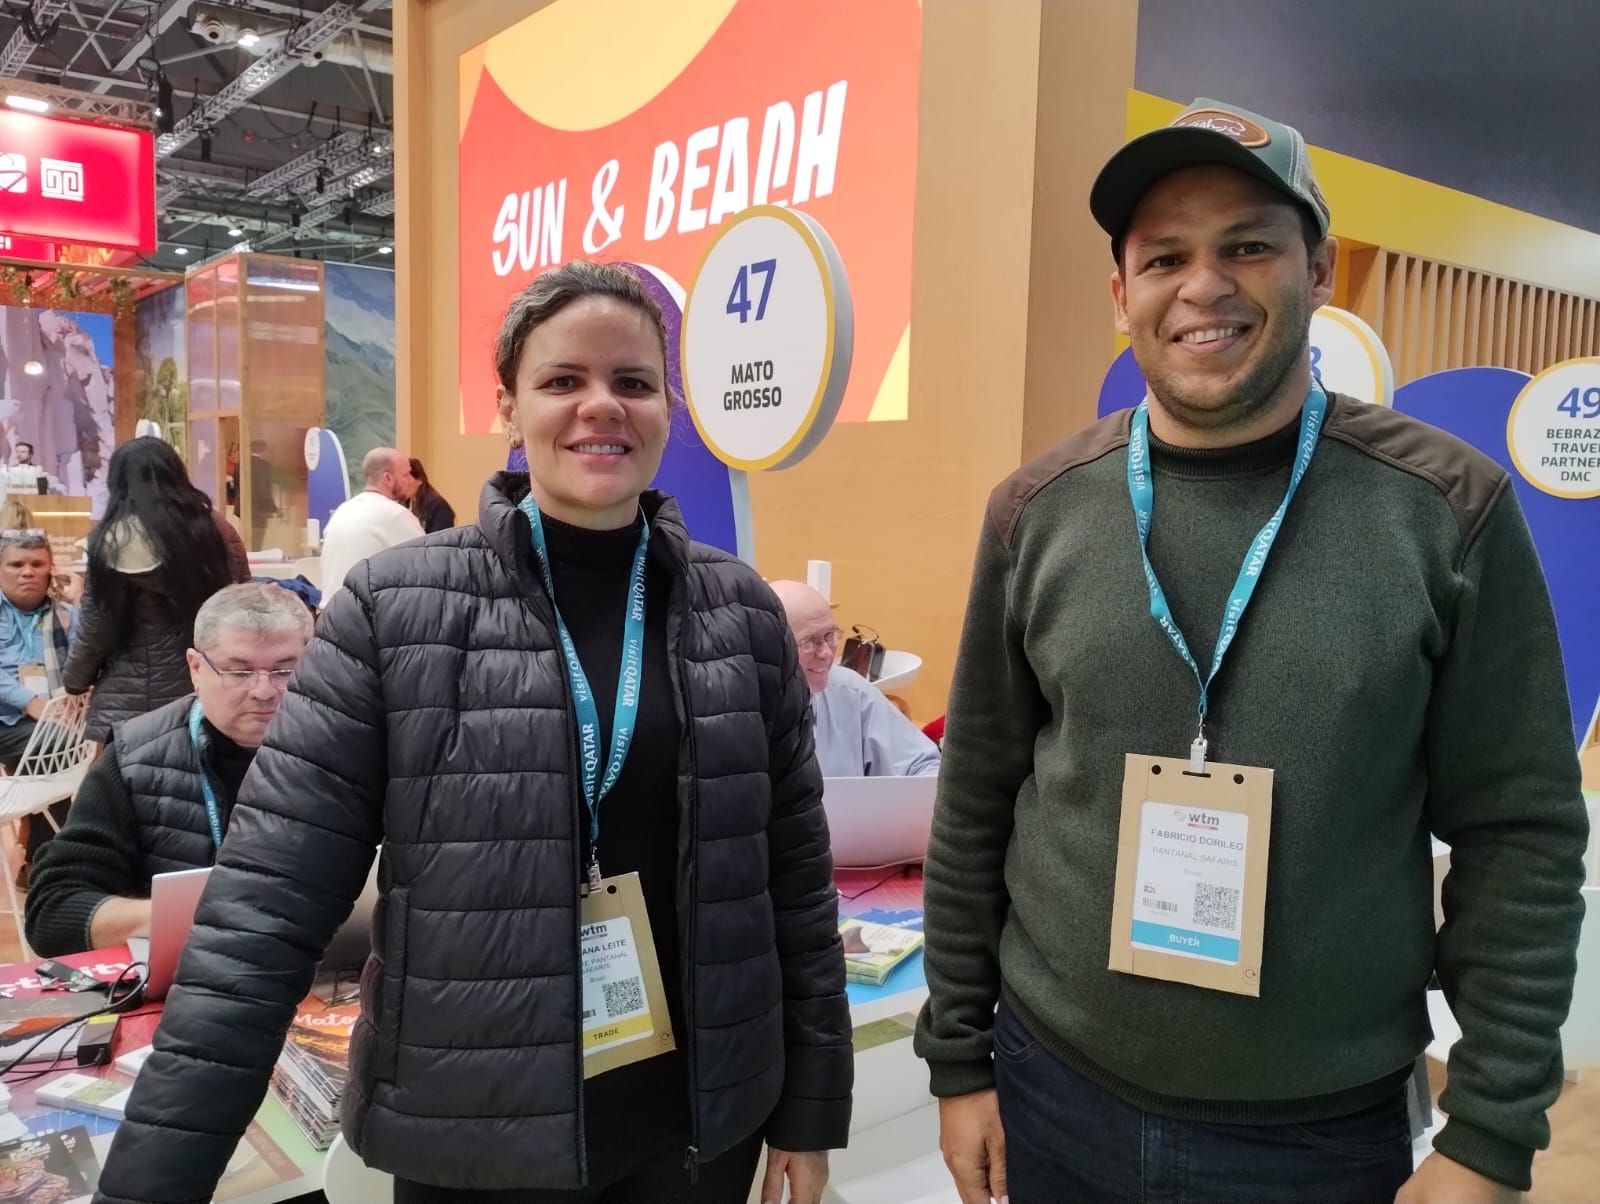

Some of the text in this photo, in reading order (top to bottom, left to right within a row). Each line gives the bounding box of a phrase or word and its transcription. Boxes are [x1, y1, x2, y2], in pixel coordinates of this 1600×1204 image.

[492, 80, 848, 276] SUN & BEACH
[726, 258, 777, 324] 47
[731, 360, 774, 384] MATO
[723, 386, 782, 411] GROSSO
[1556, 386, 1600, 419] 49
[1552, 442, 1600, 453] TRAVE
[1560, 471, 1592, 482] DMC
[631, 556, 646, 621] visitQATAR
[622, 639, 639, 708] visitQATAR
[599, 727, 629, 800] visitQATA
[1188, 812, 1220, 826] wtm
[1151, 828, 1244, 851] FABRICIO DORILEO
[1152, 846, 1198, 861] PANTANAL
[602, 939, 627, 951] LEITE
[1169, 933, 1201, 948] BUYER
[591, 952, 628, 964] PANTANAL
[593, 1027, 620, 1041] TRADE
